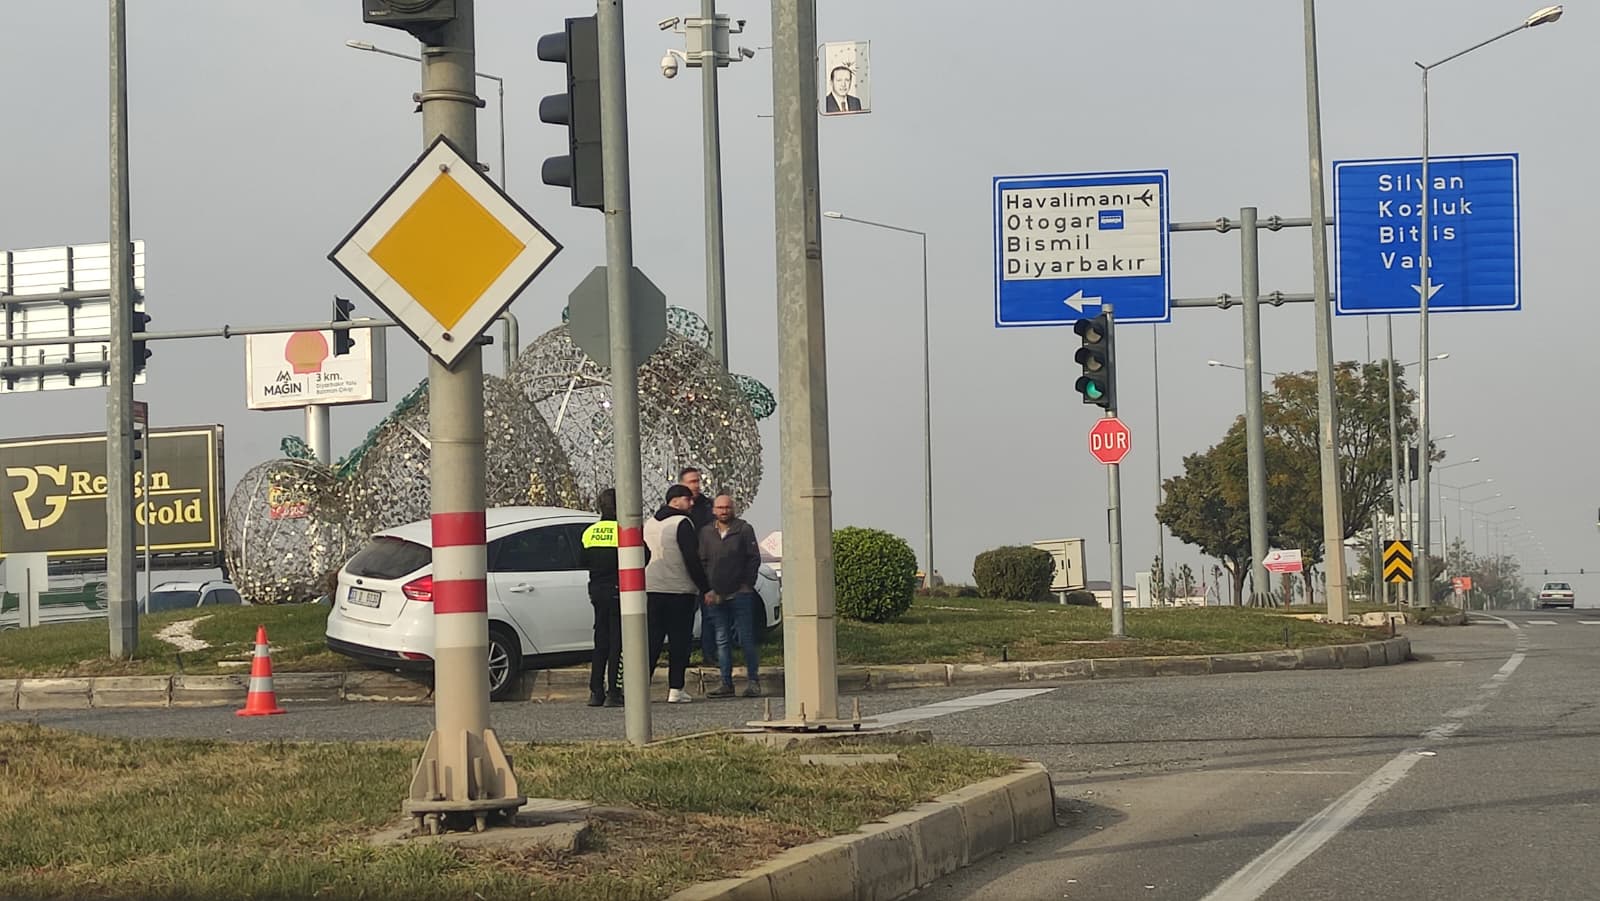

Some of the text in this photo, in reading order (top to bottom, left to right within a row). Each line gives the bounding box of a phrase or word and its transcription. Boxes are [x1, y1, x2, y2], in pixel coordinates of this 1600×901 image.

[1378, 174, 1464, 192] Silvan
[1006, 192, 1130, 209] Havalimanı
[1007, 214, 1094, 233] Otogar
[1007, 233, 1090, 252] Bismil
[1379, 225, 1456, 244] Bitis
[1007, 254, 1145, 278] Diyarbakır
[315, 373, 322, 382] 3
[264, 381, 302, 396] MAĞIN
[1092, 432, 1126, 451] DUR
[135, 498, 203, 527] Gold
